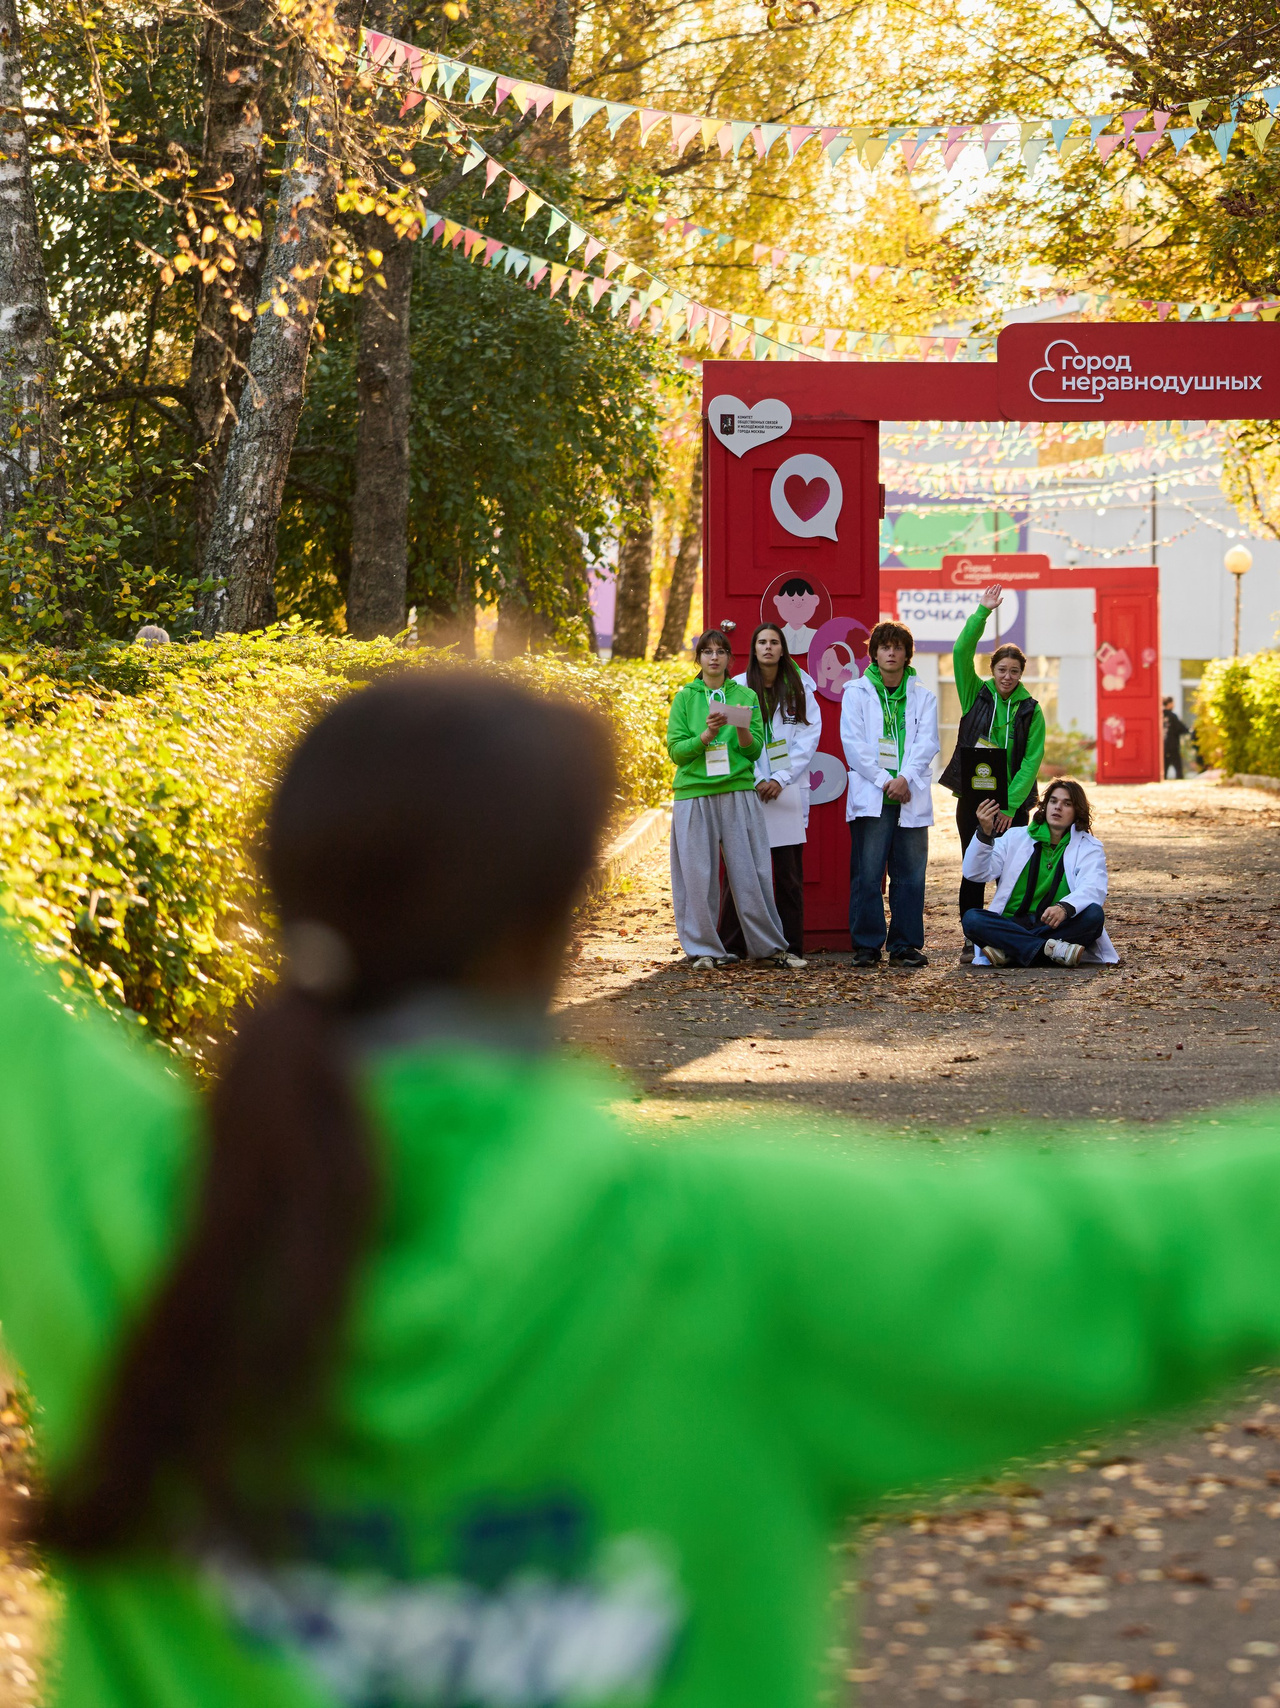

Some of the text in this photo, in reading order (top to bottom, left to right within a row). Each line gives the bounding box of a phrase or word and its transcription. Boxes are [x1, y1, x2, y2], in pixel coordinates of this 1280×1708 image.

[1062, 355, 1132, 374] город
[1062, 375, 1262, 395] неравнодушных
[901, 609, 966, 620] ТОЧКА
